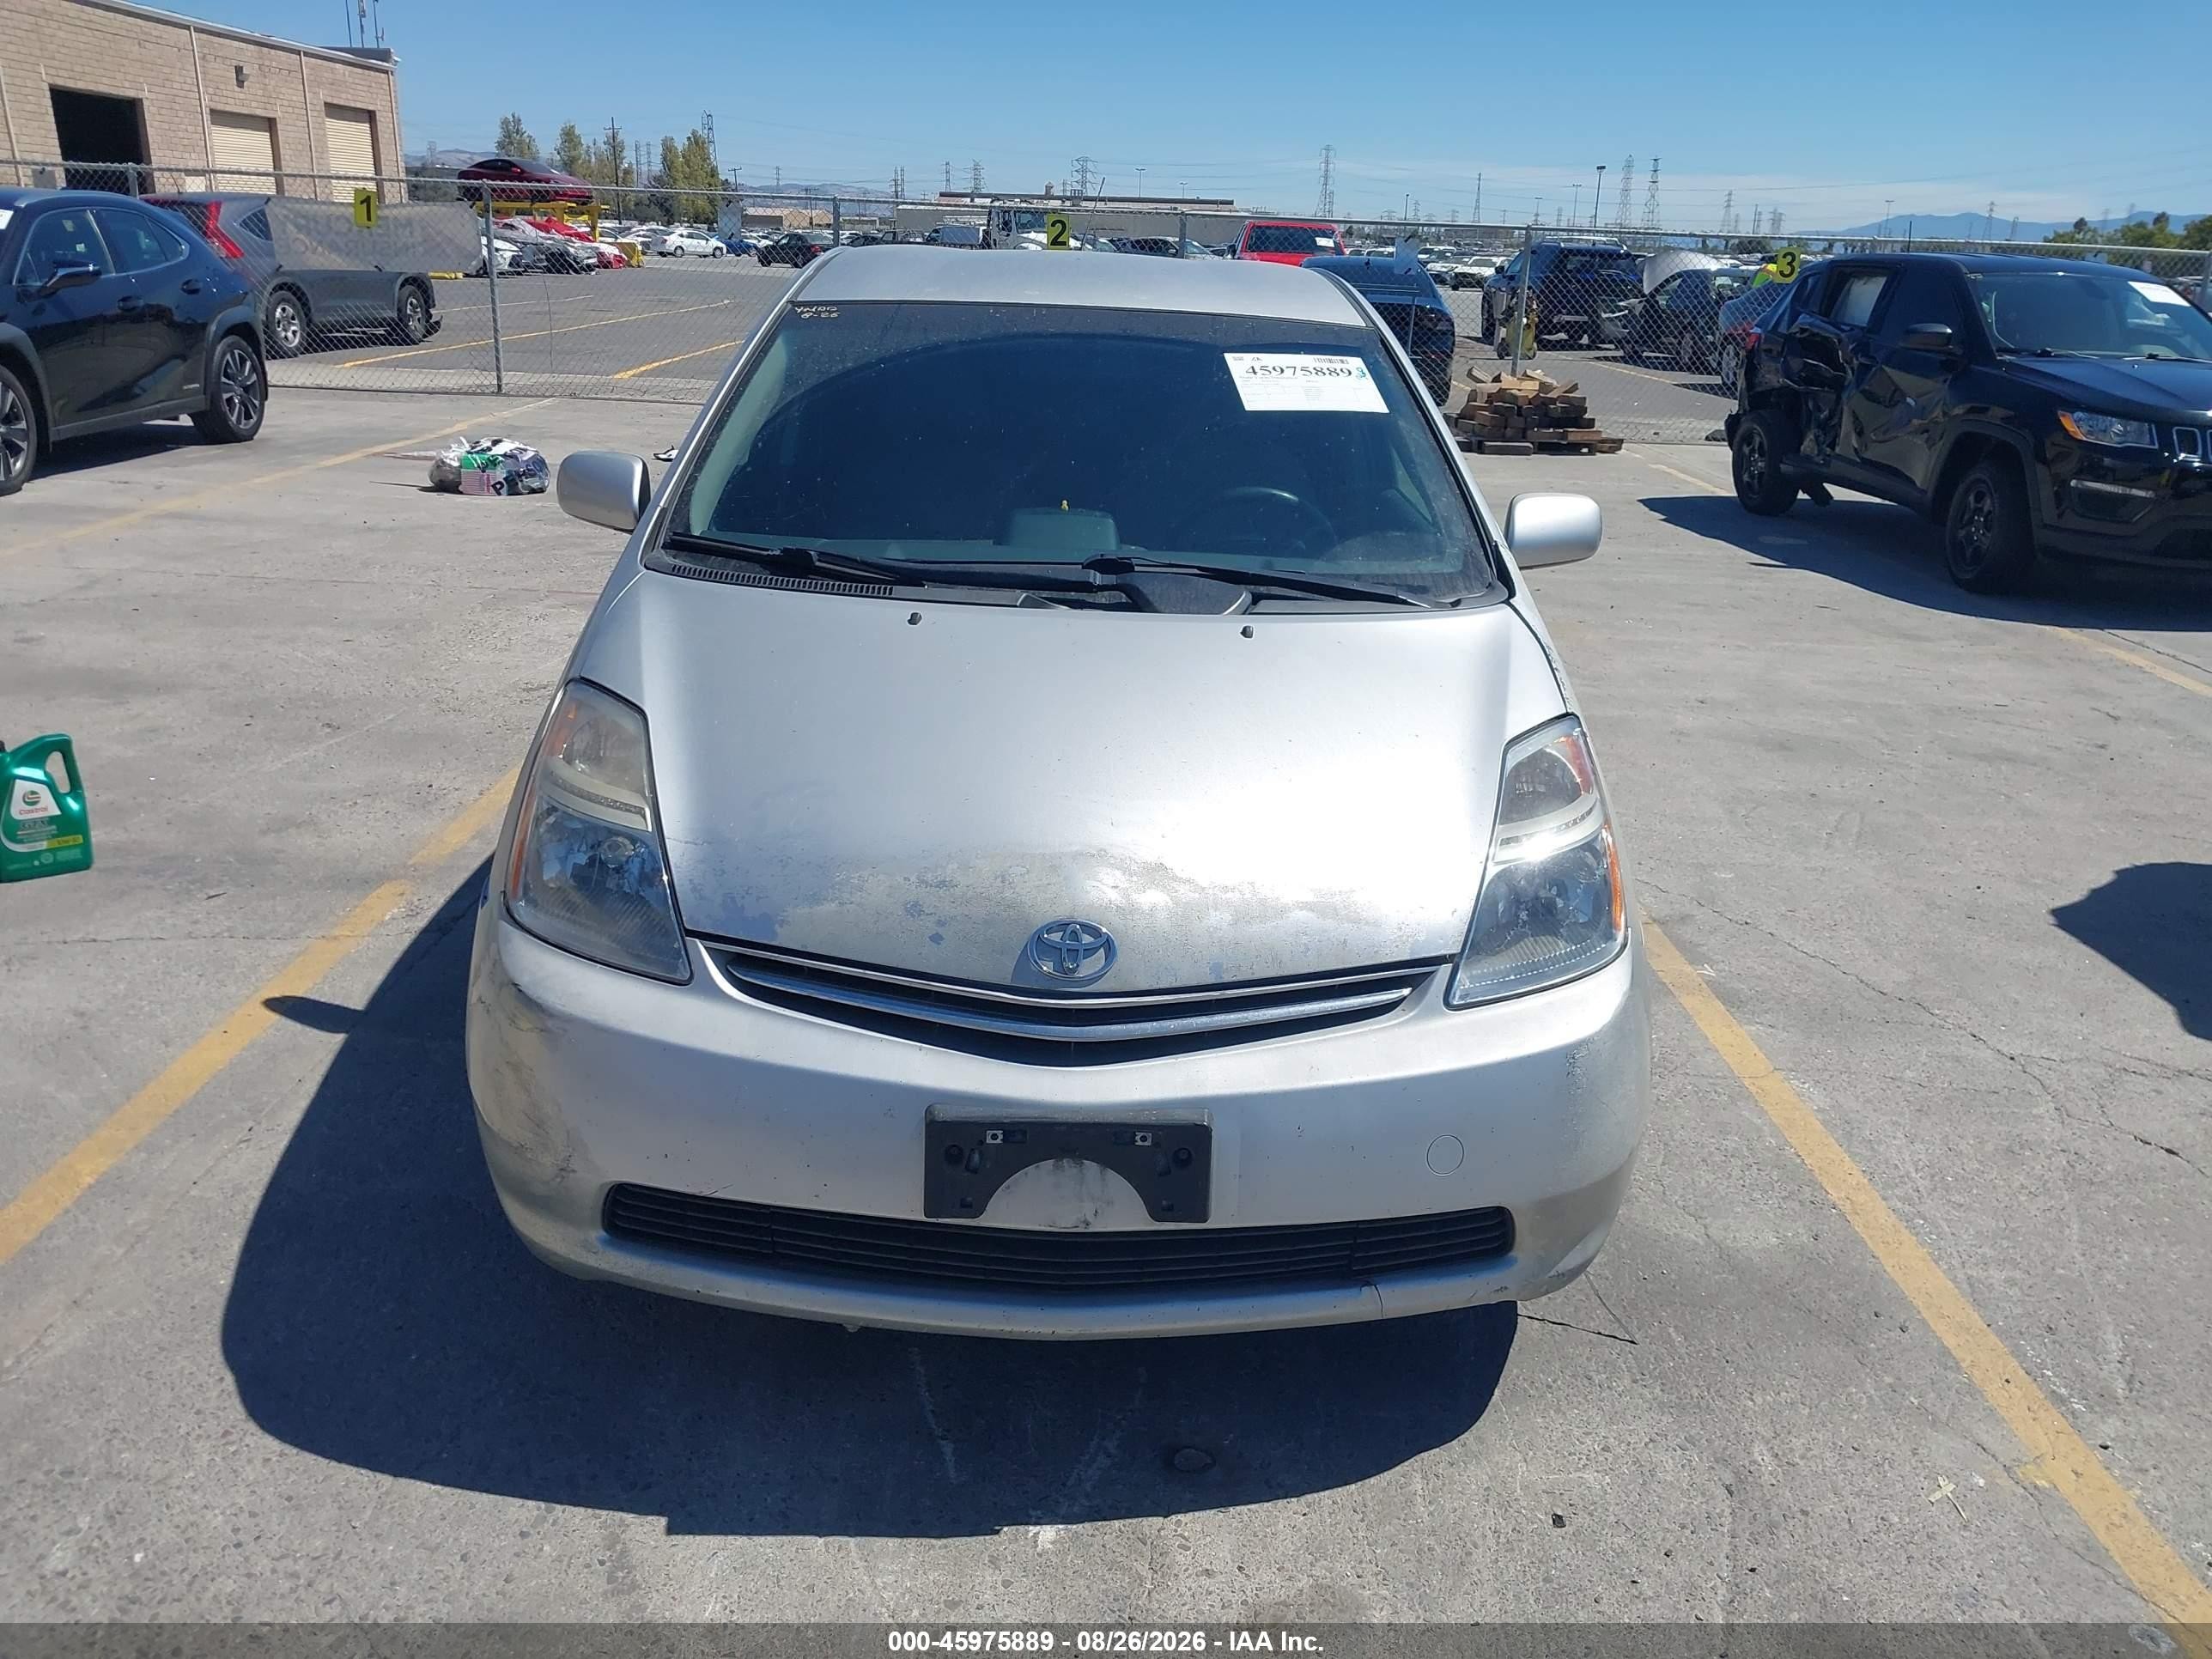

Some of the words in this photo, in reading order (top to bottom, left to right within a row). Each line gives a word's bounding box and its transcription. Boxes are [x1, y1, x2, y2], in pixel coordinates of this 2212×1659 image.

[360, 195, 371, 222] 1
[1050, 219, 1066, 246] 2
[1779, 251, 1796, 278] 3
[1245, 365, 1352, 377] 45975889
